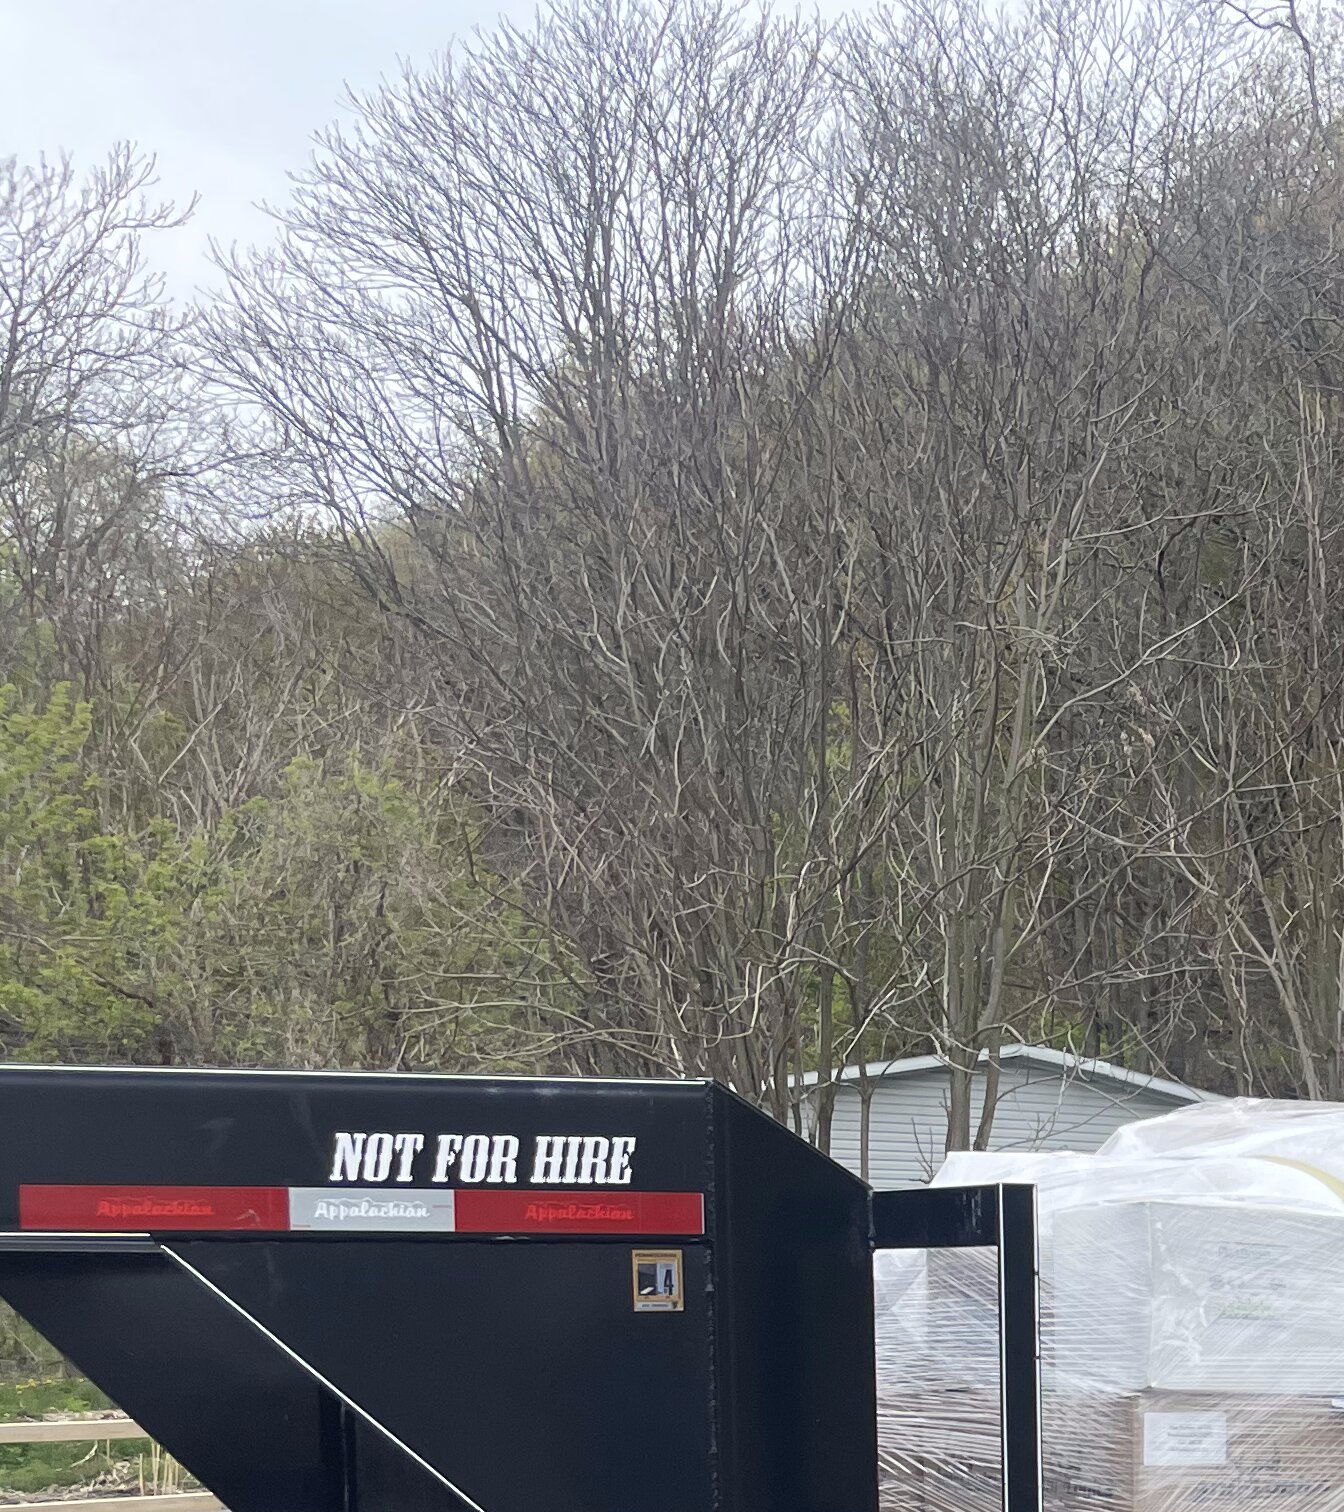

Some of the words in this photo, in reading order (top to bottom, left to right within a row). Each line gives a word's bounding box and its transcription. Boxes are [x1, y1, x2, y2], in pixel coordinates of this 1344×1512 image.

[330, 1133, 424, 1182] NOT
[432, 1134, 520, 1183] FOR
[530, 1136, 637, 1184] HIRE
[314, 1199, 430, 1220] Appalachian
[525, 1202, 634, 1222] Appalachian
[664, 1269, 674, 1296] 4
